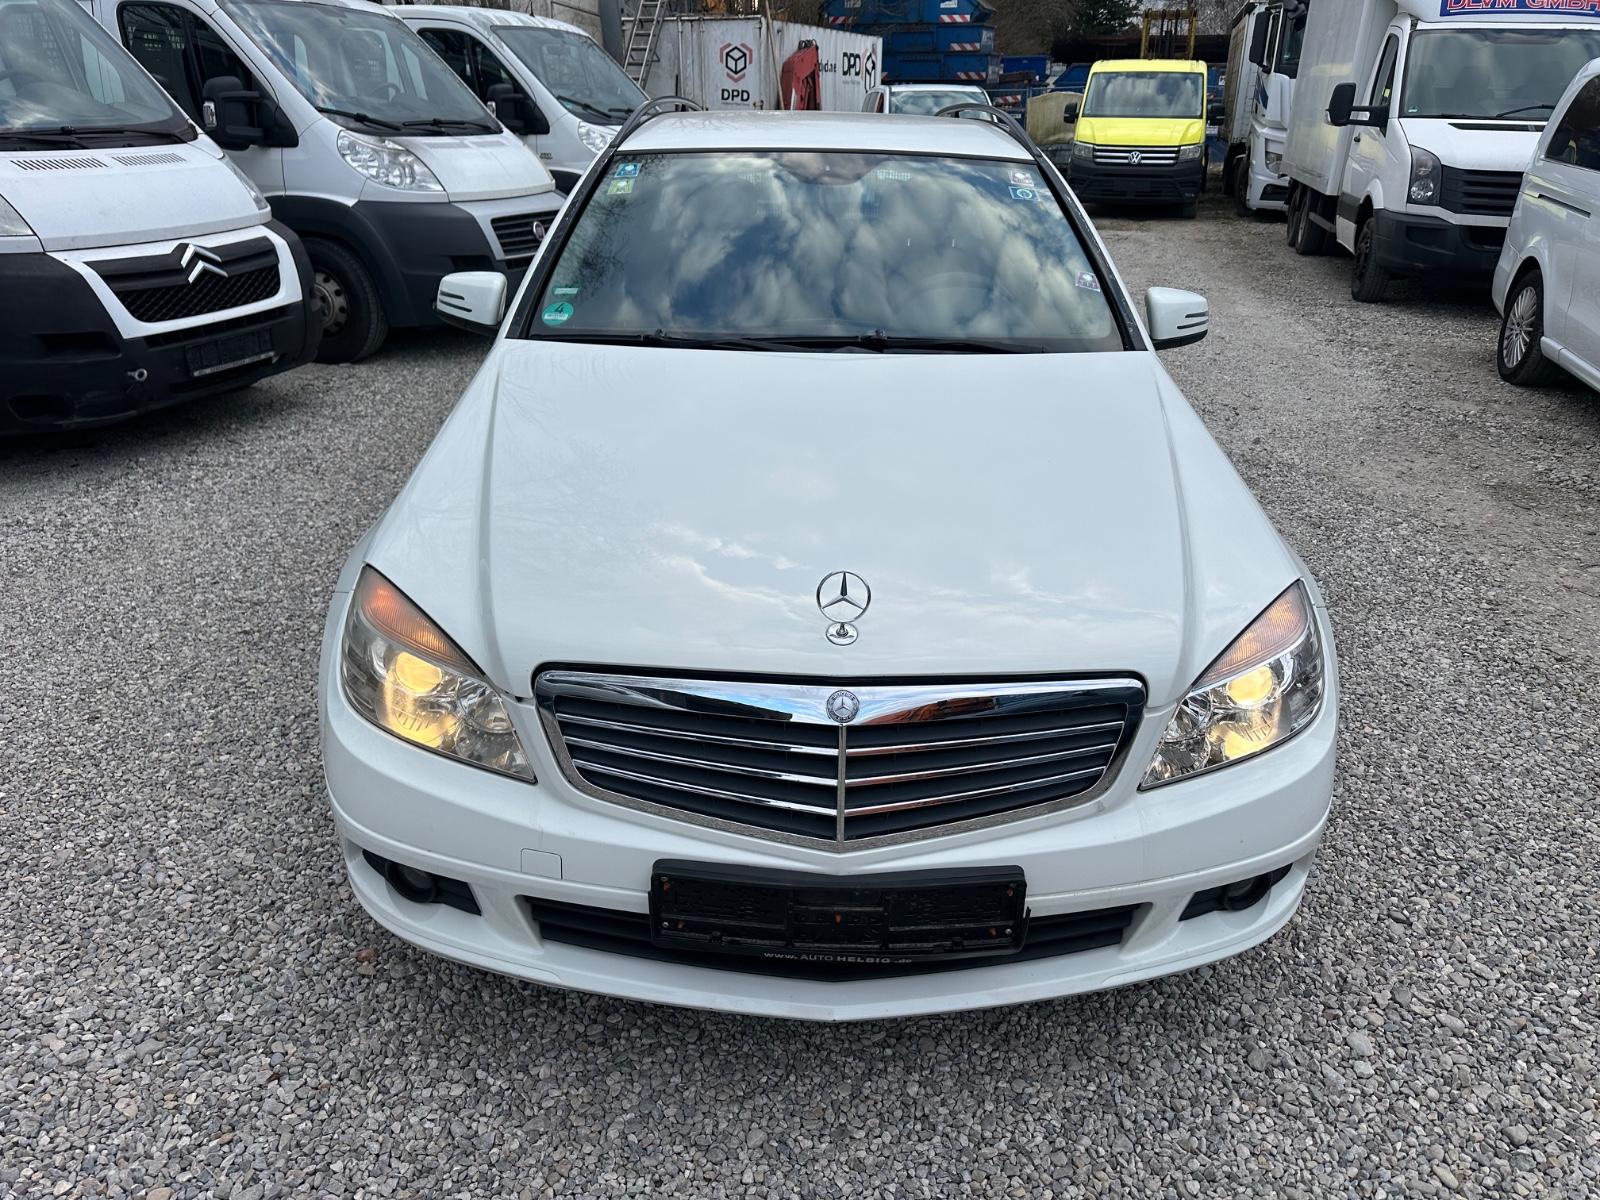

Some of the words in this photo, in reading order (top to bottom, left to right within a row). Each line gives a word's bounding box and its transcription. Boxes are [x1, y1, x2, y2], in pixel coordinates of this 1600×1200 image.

[842, 52, 861, 76] DPD
[721, 88, 750, 102] DPD
[554, 303, 565, 314] 4
[763, 952, 798, 960] www.
